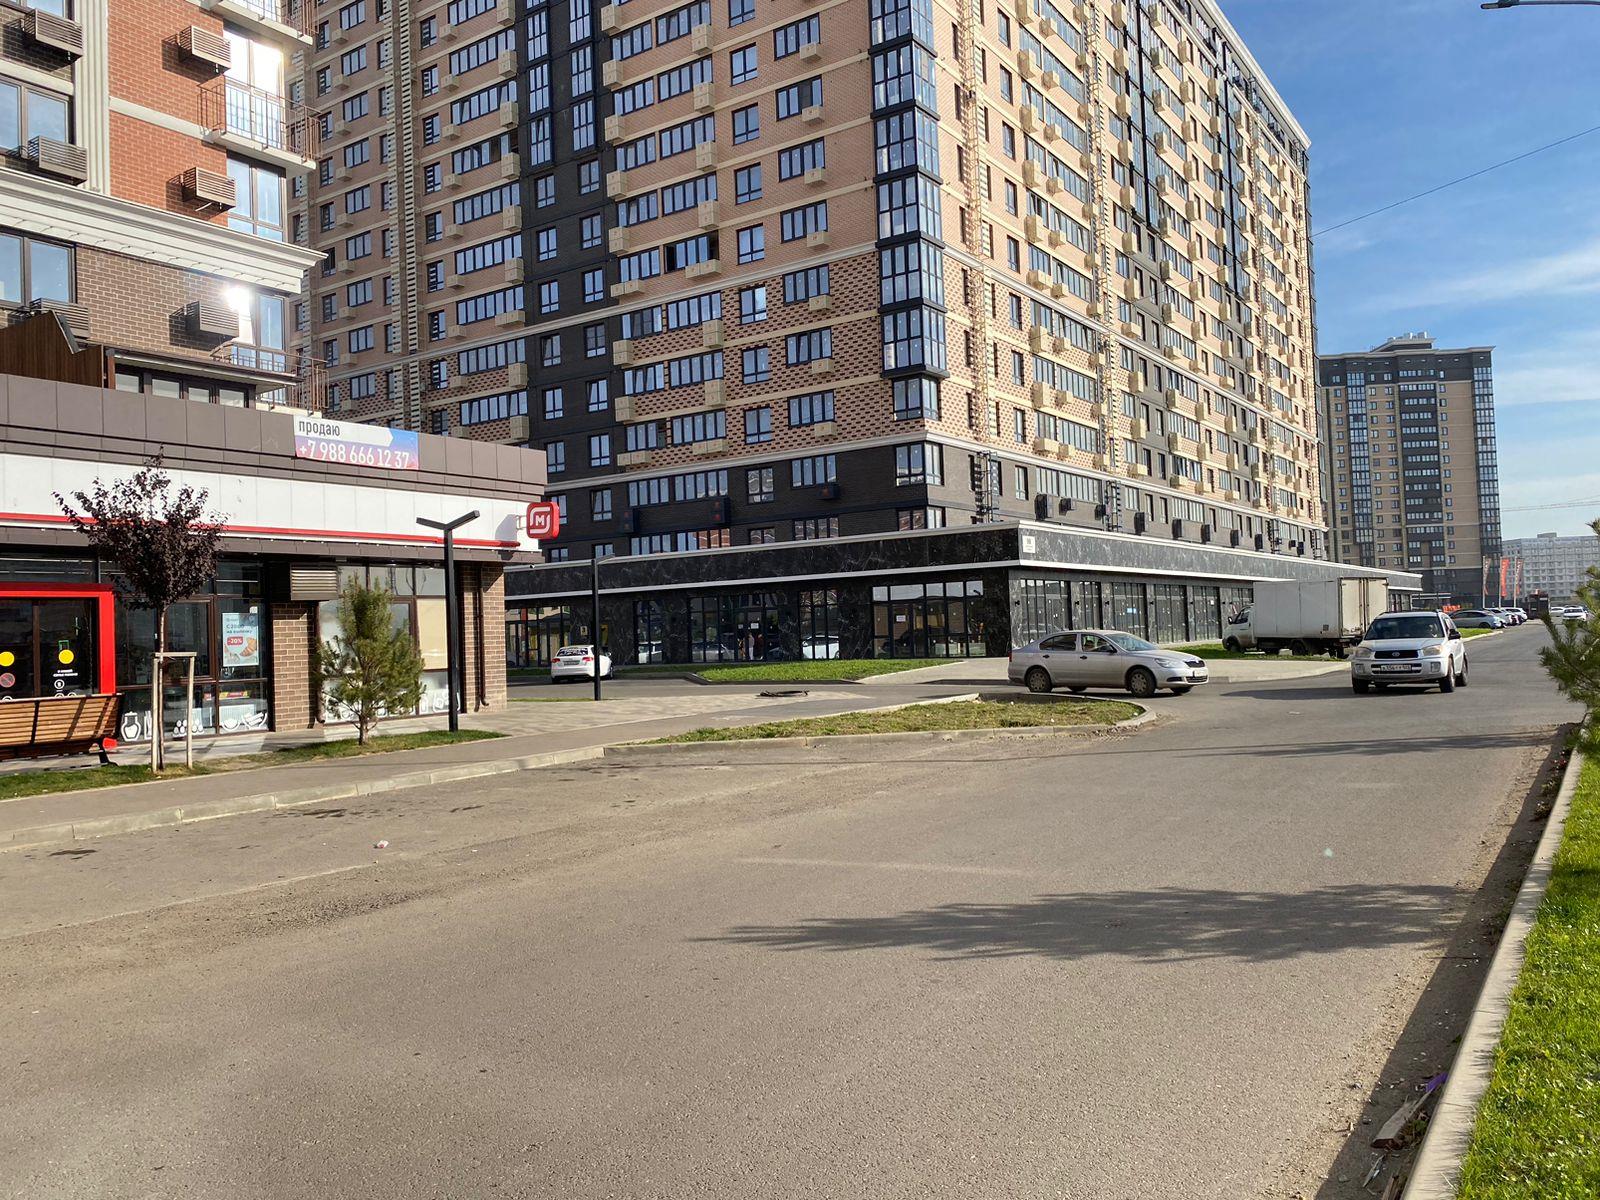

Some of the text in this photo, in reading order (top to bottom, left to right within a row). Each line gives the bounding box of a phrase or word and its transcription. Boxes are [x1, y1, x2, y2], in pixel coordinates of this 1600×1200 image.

[299, 421, 340, 436] продаю
[300, 440, 410, 469] +7 988 666 12 37
